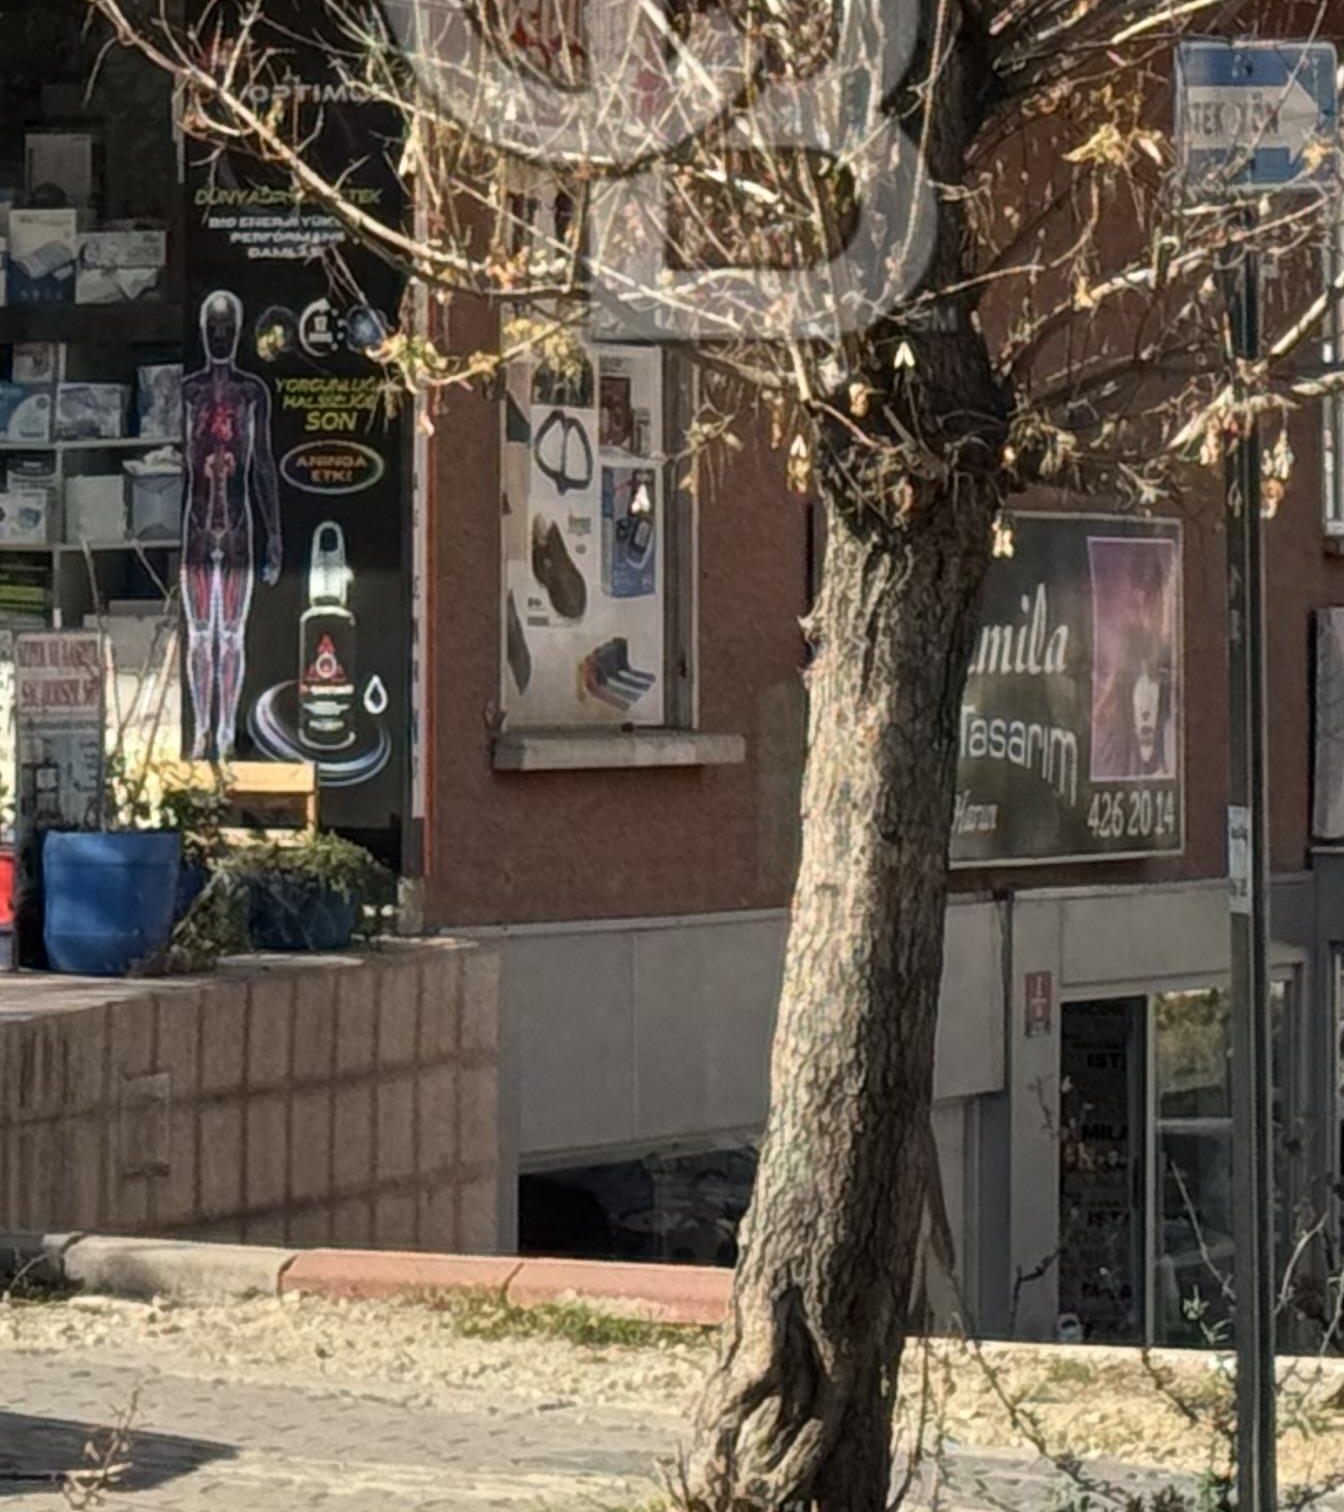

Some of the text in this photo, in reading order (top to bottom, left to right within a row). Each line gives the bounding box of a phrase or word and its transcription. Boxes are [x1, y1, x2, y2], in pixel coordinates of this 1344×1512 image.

[305, 410, 358, 432] SON
[1088, 790, 1176, 838] 426 20 14
